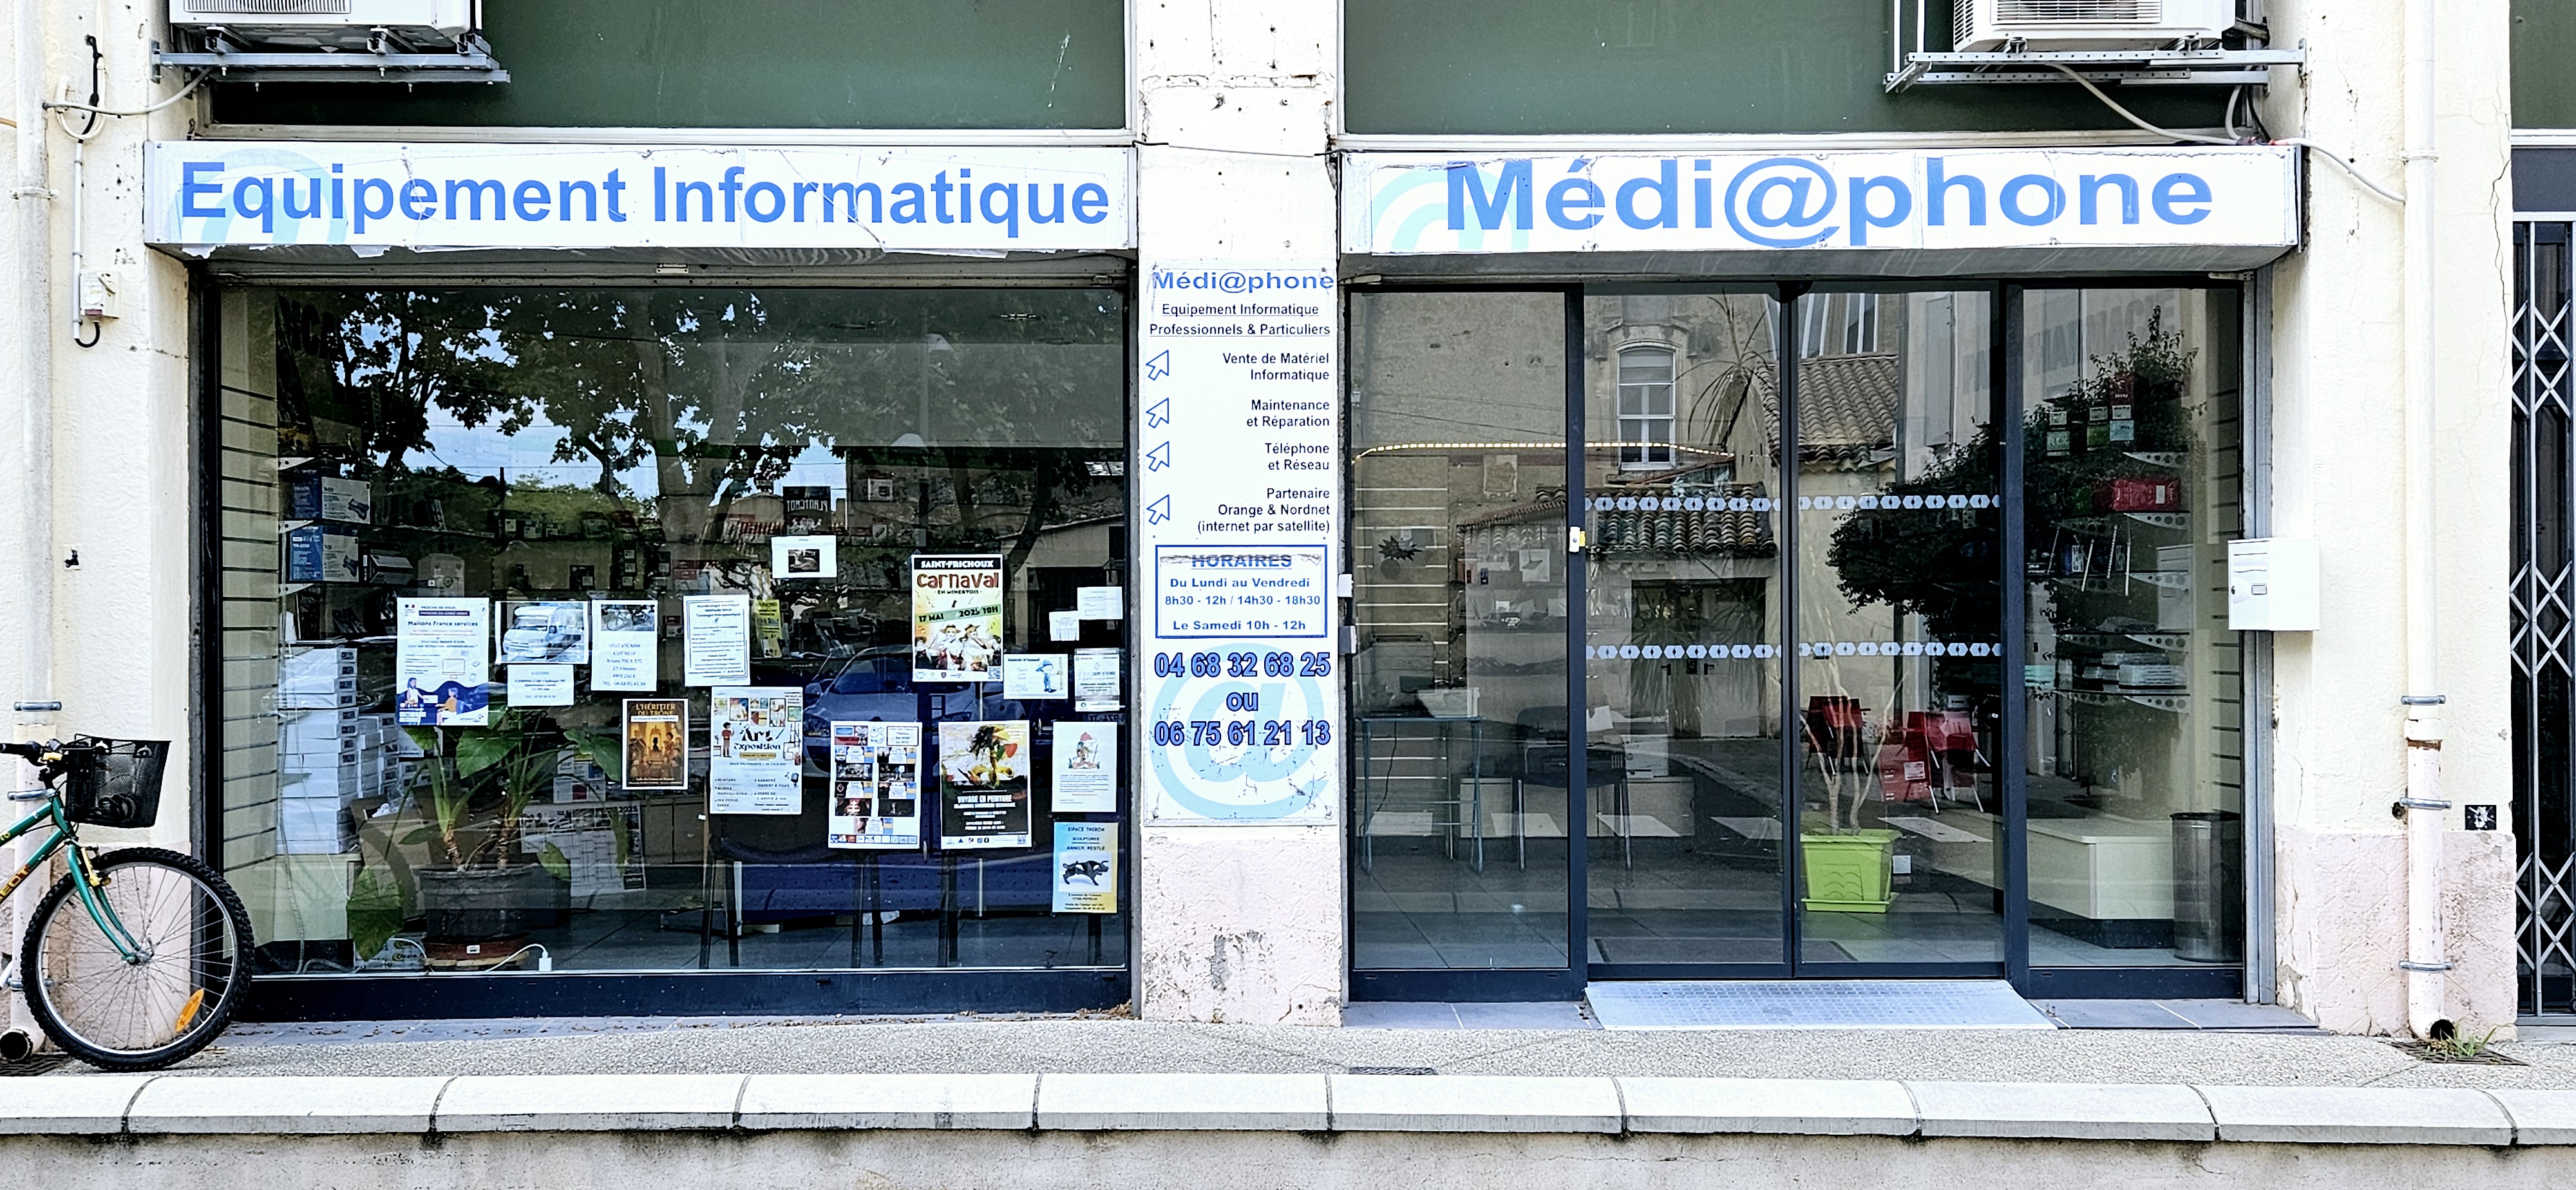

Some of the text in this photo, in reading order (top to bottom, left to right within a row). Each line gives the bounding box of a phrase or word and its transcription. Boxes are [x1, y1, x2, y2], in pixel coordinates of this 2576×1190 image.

[178, 160, 1108, 242] Equipement Informatique
[1446, 156, 2214, 247] Médi@phone
[1153, 272, 1334, 293] Médi@phone
[1163, 304, 1318, 316] Equipement Informatique
[1150, 324, 1330, 334] Professionnels & Particuliers
[1223, 353, 1328, 363] Vente de Matériel
[1251, 370, 1329, 382] Informatique
[1252, 399, 1329, 410] Maintenance
[1247, 416, 1329, 429] et Réparation
[1265, 443, 1329, 457] Téléphone
[1269, 459, 1329, 470] et Réseau
[1267, 487, 1329, 498] Partenaire
[1218, 504, 1330, 517] Orange & Nordnet
[1198, 520, 1329, 534] (internet par satellite)
[1192, 555, 1292, 567] HORAIRES
[1192, 578, 1226, 587] Lundi
[1253, 578, 1309, 587] Vendredi
[1166, 596, 1193, 605] 8h30
[1206, 596, 1226, 605] 12h
[1238, 596, 1273, 605] 14h30
[1285, 596, 1320, 605] 18h30
[1194, 621, 1240, 629] Samedi
[1247, 621, 1269, 629] 10h
[1283, 621, 1305, 629] 12h
[1155, 652, 1331, 677] 04 68 32 68 25
[1226, 692, 1258, 712] ou
[742, 728, 773, 741] Art
[1154, 721, 1331, 746] 06 75 61 21 13
